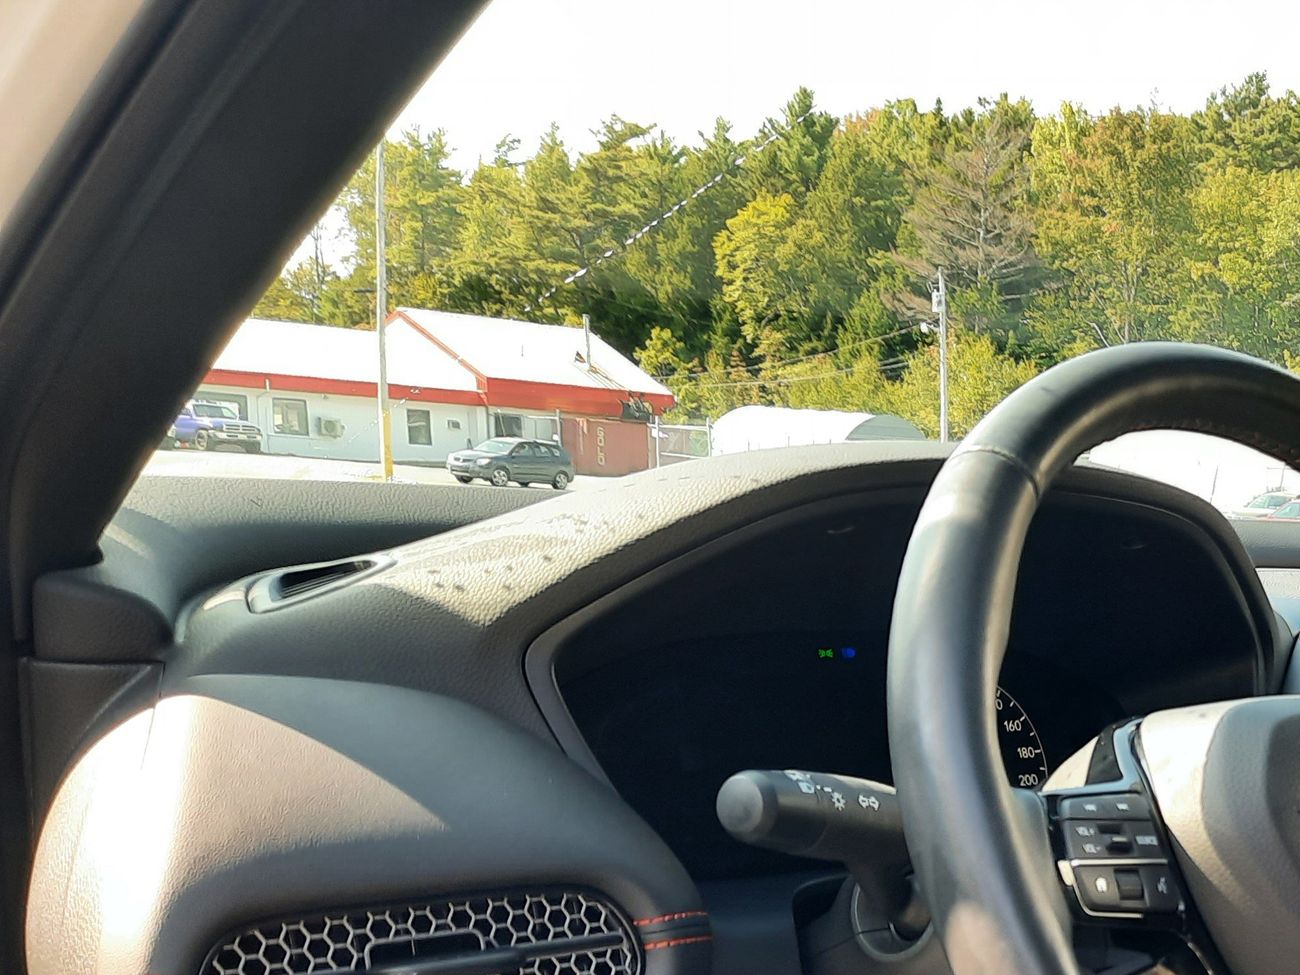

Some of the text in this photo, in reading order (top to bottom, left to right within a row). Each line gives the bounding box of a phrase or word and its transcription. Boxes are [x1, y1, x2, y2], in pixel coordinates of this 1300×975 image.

[1003, 719, 1022, 732] 160
[1017, 746, 1035, 759] 180
[1018, 773, 1039, 787] 200
